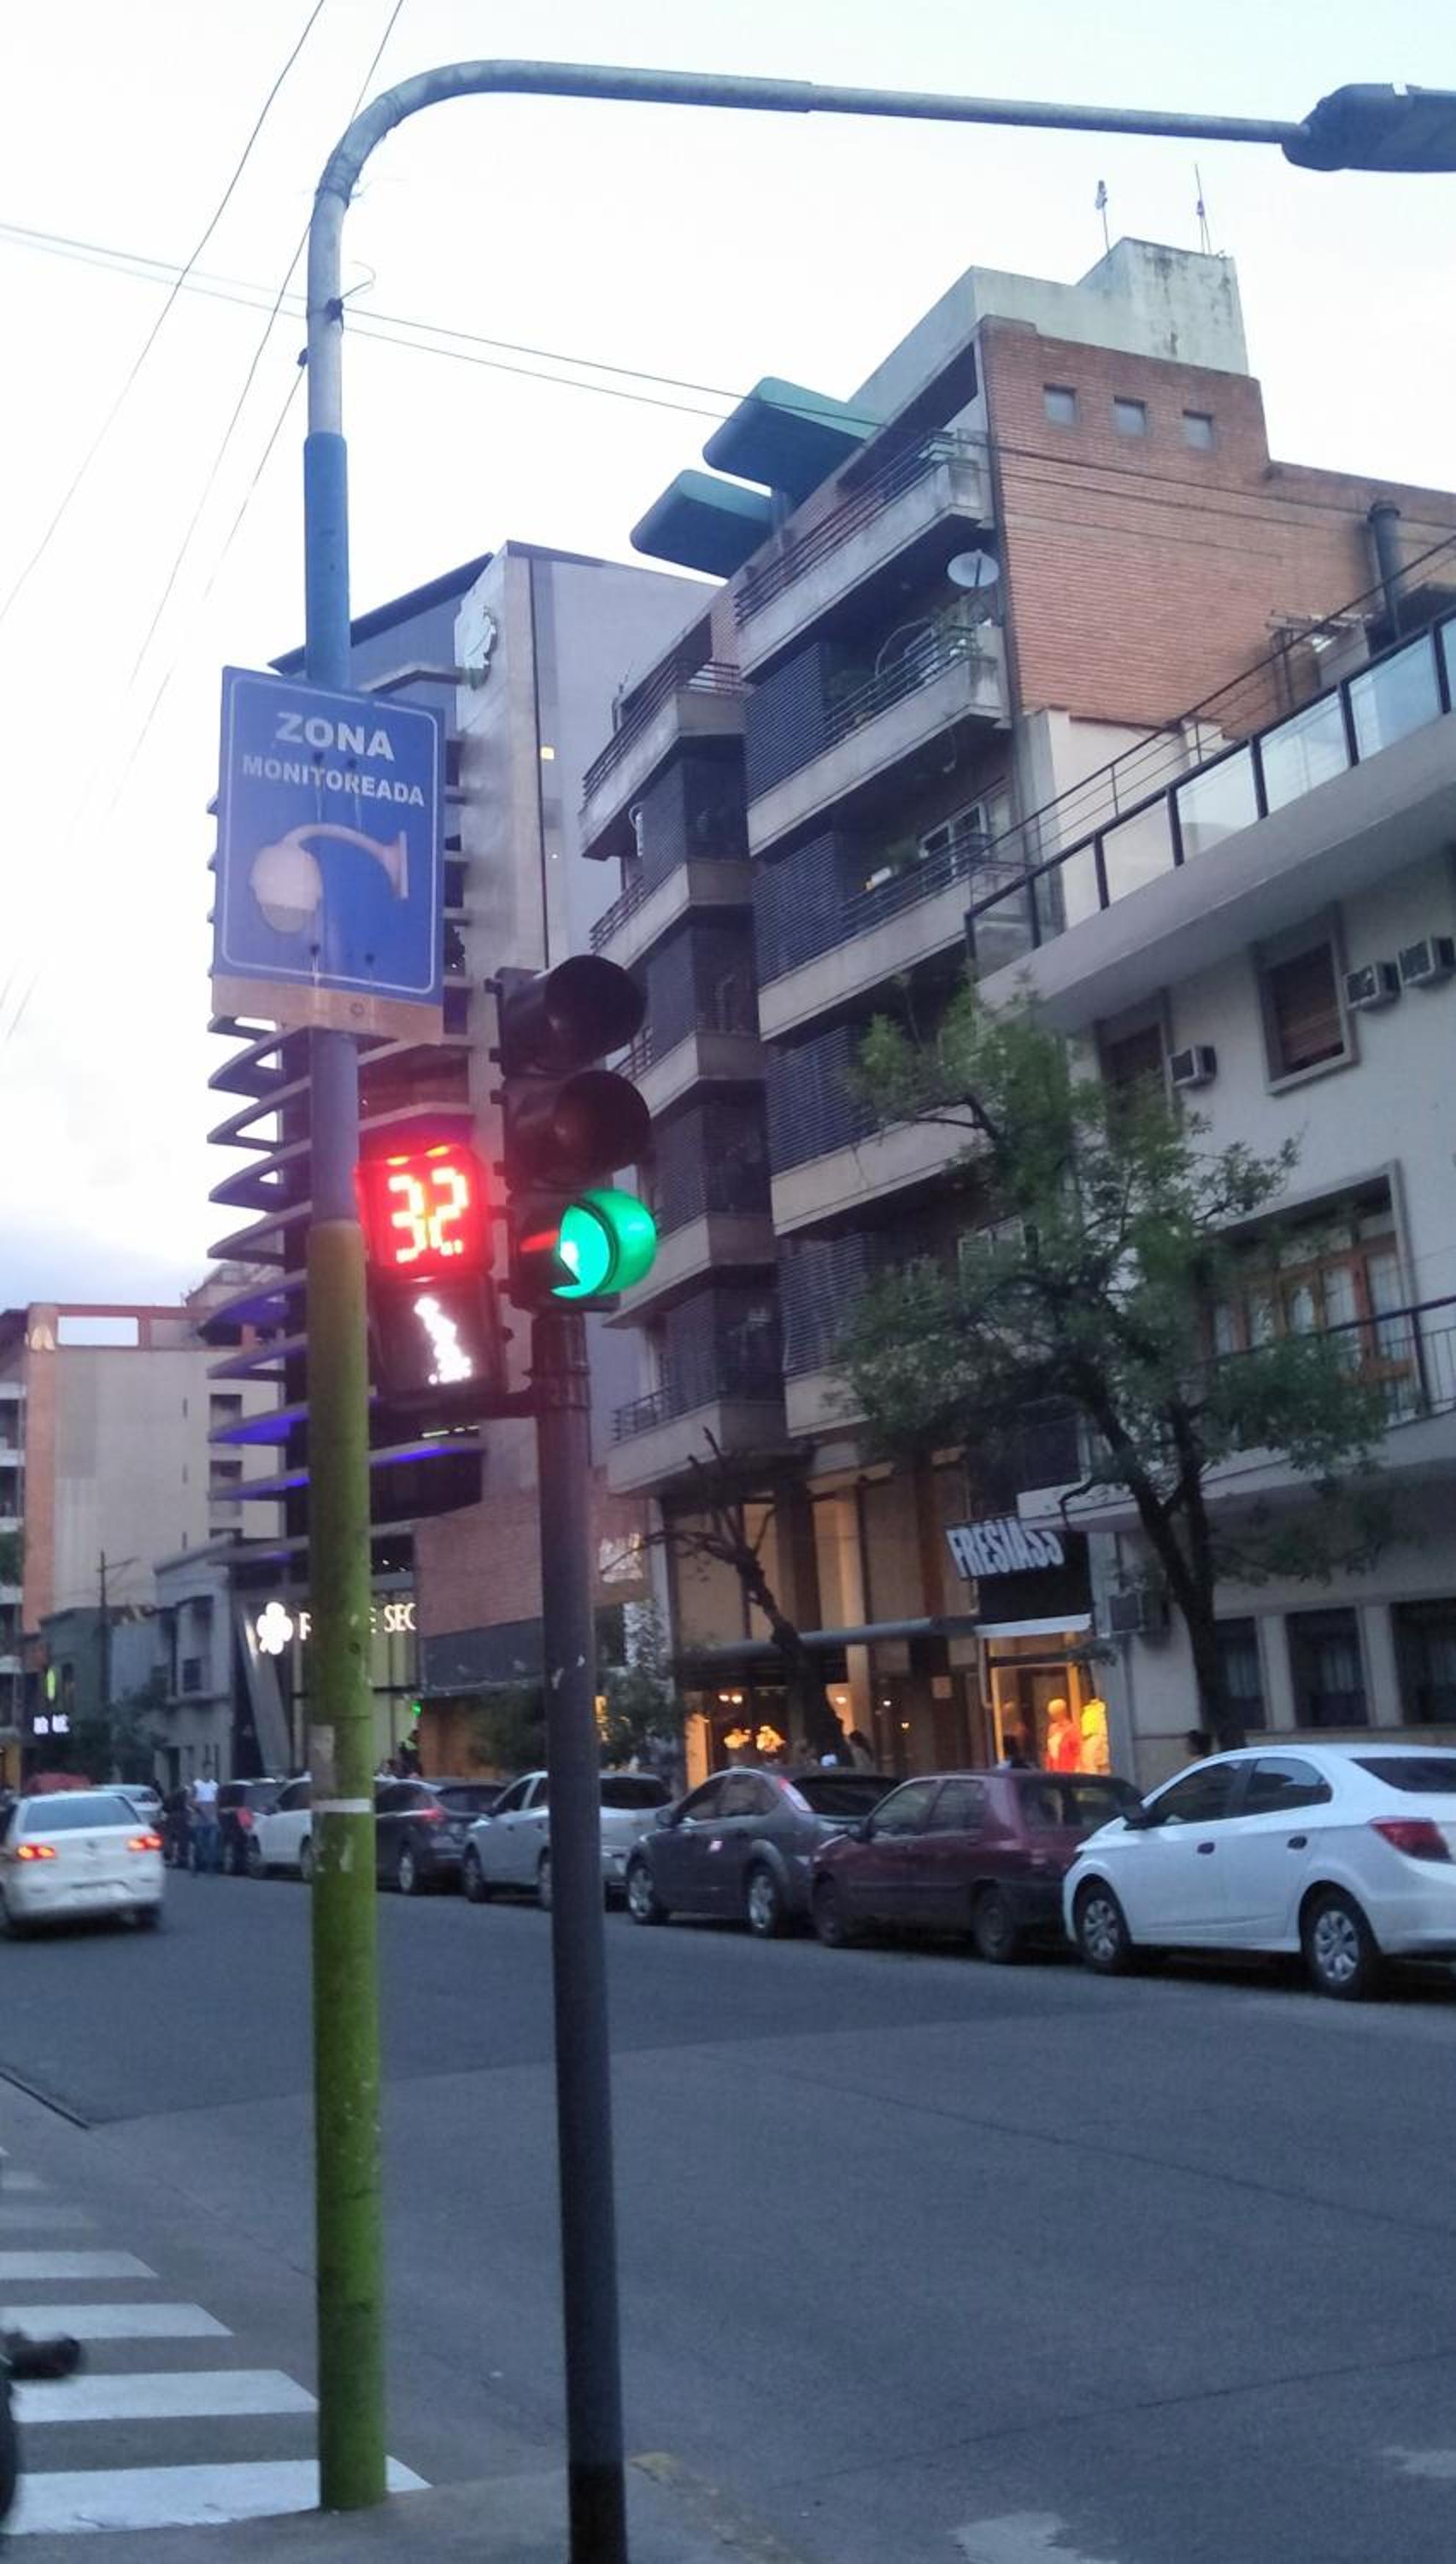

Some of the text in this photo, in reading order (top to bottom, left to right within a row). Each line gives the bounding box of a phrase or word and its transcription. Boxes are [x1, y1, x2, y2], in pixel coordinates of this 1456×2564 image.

[275, 711, 395, 762] ZONA
[243, 754, 425, 807] MONITOREADA
[388, 1167, 469, 1264] 32
